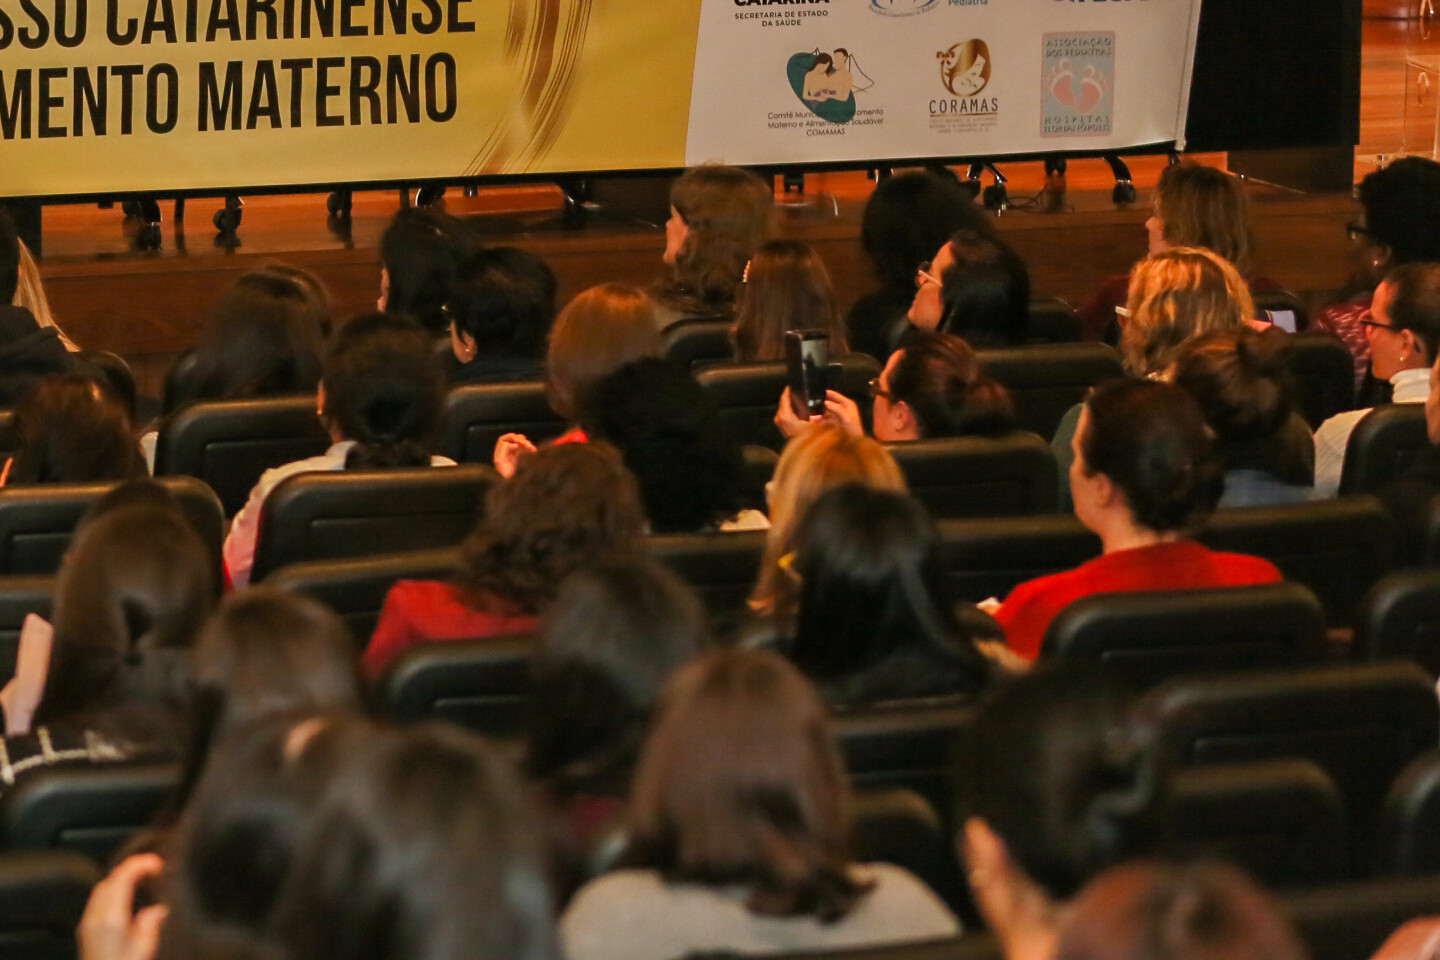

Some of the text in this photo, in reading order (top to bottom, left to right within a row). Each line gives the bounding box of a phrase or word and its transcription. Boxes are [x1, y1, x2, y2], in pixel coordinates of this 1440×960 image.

[735, 11, 782, 20] SECRETARIA
[798, 10, 829, 18] ESTADO
[197, 52, 457, 132] MATERNO
[929, 98, 998, 114] CORAMAS
[767, 111, 793, 120] Comitê
[767, 121, 797, 129] Materno
[806, 128, 846, 137] COMAMAS
